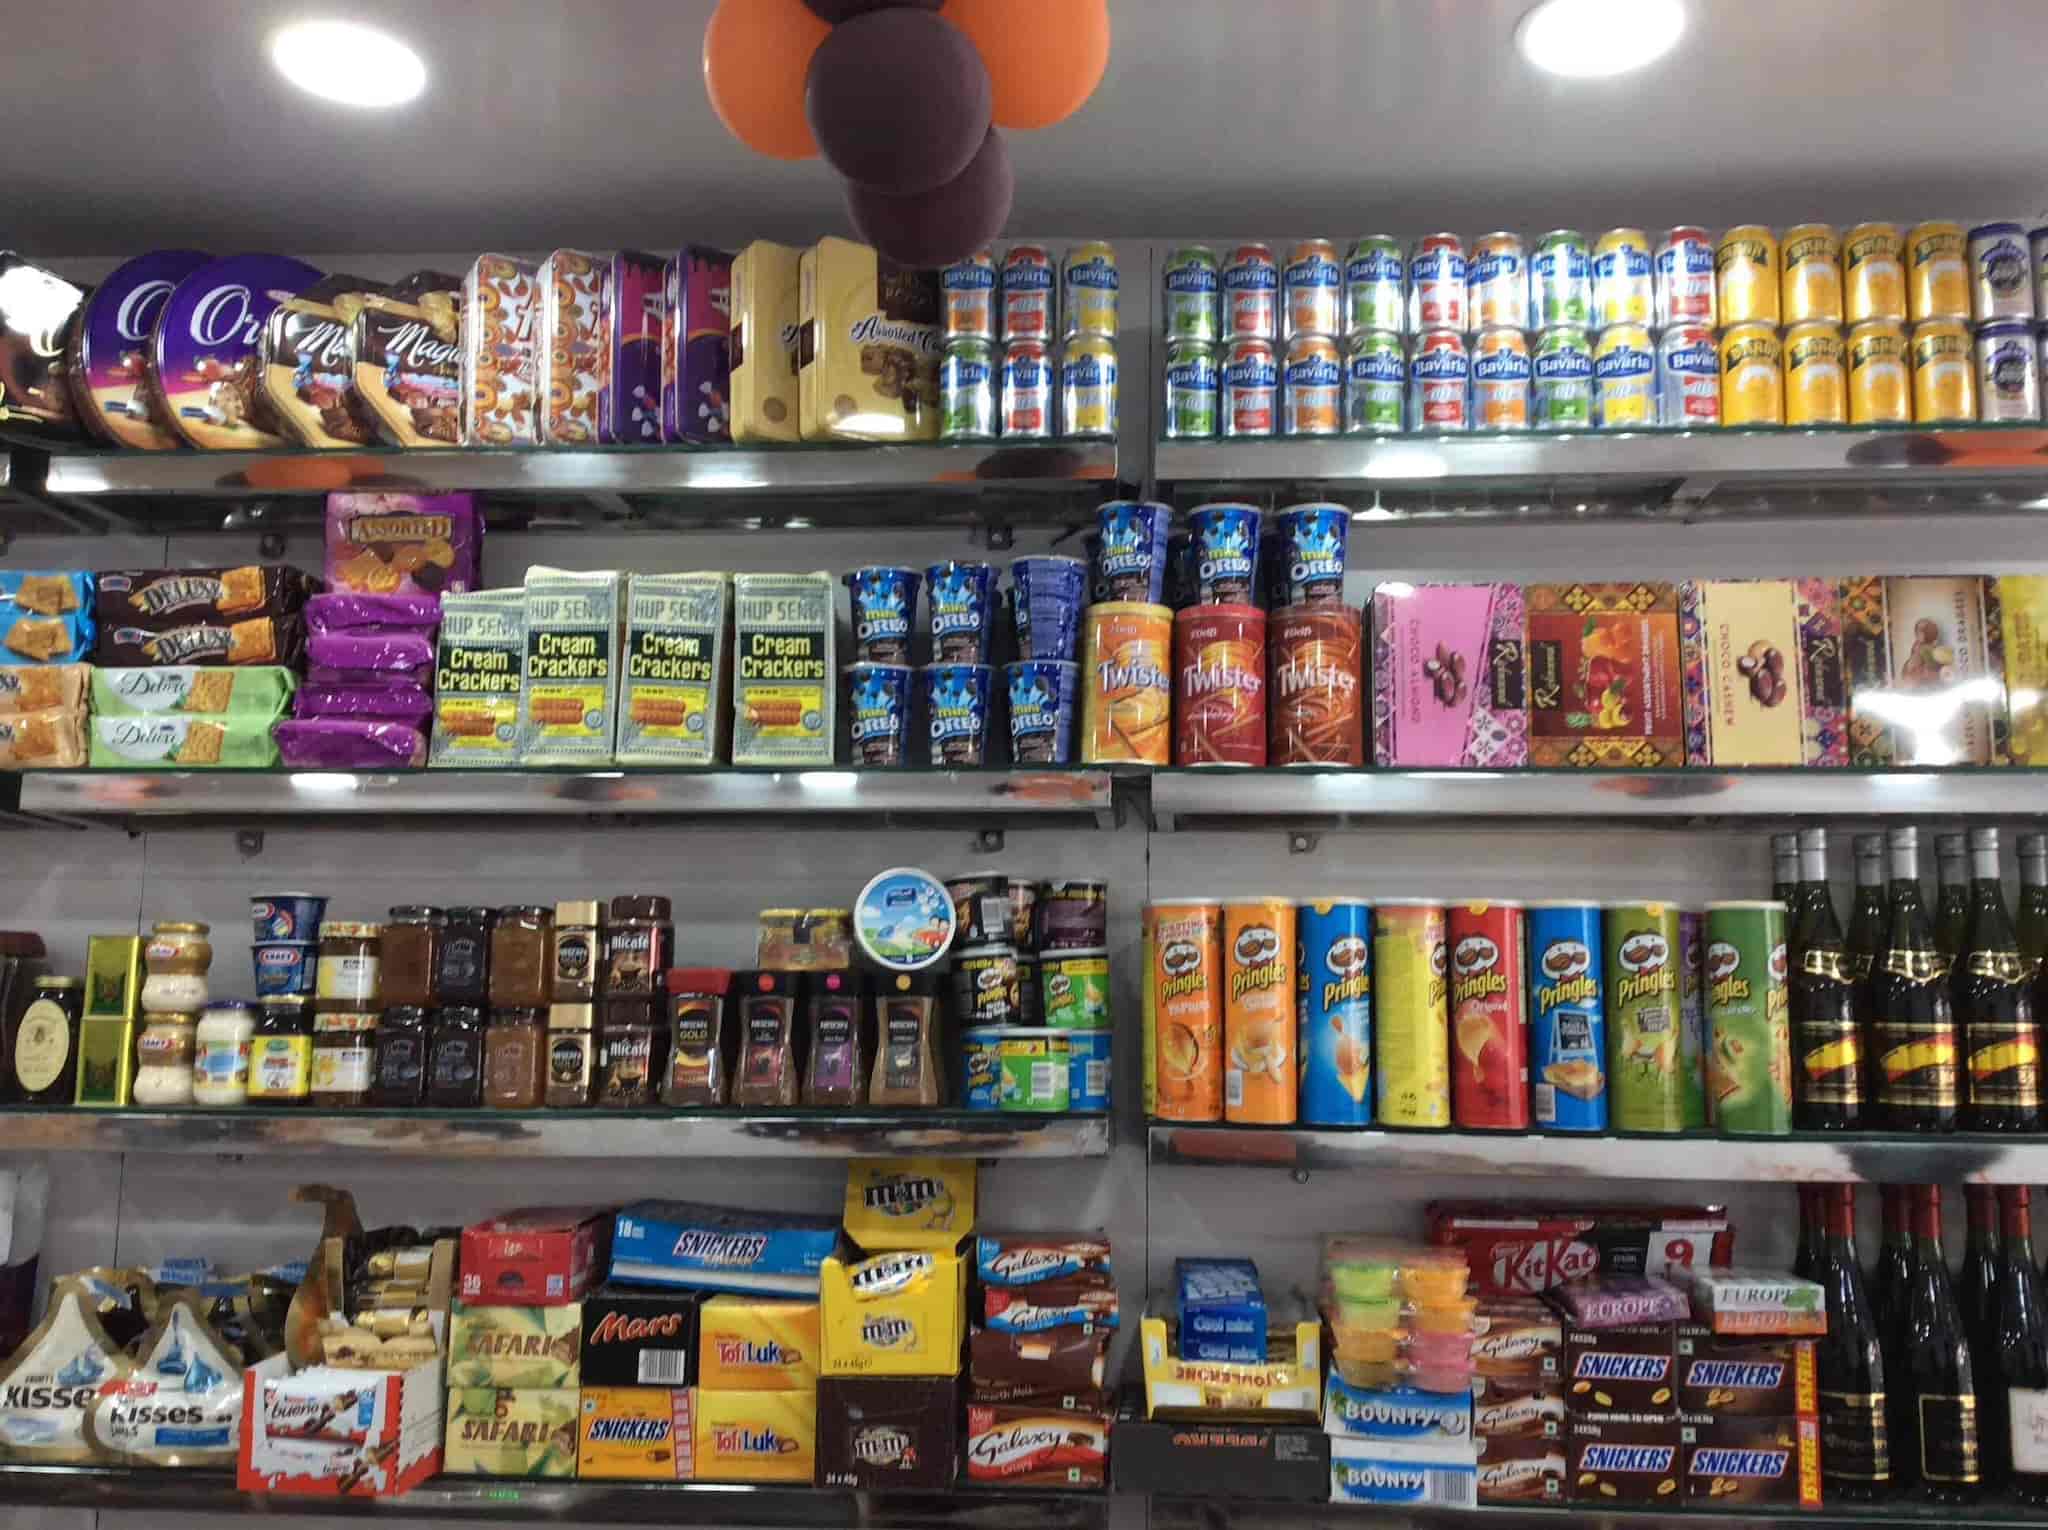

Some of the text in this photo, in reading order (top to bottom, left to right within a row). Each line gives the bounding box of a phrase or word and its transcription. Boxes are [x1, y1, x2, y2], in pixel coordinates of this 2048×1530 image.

[1478, 358, 1528, 376] Bavaria
[1539, 355, 1590, 372] Bavaria
[1598, 355, 1650, 372] Bavaria
[1103, 553, 1148, 575] OREO
[1200, 558, 1250, 578] OREO
[1291, 559, 1343, 580] OREO
[858, 618, 908, 638] OREO
[932, 612, 980, 634] OREO
[539, 633, 596, 656] Cream
[642, 632, 700, 656] Cream
[752, 633, 812, 655] Cream
[1719, 623, 1731, 669] CHOCO
[451, 648, 508, 671] Cream
[528, 654, 608, 678] Crackers
[629, 653, 712, 681] Crackers
[741, 656, 825, 678] Crackers
[438, 669, 521, 692] Crackers
[1183, 662, 1261, 697] Twister
[1278, 662, 1357, 697] Twister
[851, 717, 899, 738] OREO
[931, 717, 981, 738] OREO
[1010, 713, 1056, 736] OREO
[1161, 972, 1208, 1007] Pringles
[1231, 960, 1287, 1001] Pringles
[1618, 968, 1676, 1009] Pringles
[1541, 974, 1598, 1016] Pringles
[676, 1229, 767, 1259] SNICKERS
[1664, 1238, 1695, 1271] 9
[992, 1249, 1068, 1280] Galaxy
[1491, 1236, 1599, 1293] KitKat
[1585, 1299, 1661, 1321] EUROPE
[590, 1311, 683, 1345] Mars
[1482, 1335, 1540, 1358] Galaxy
[1579, 1354, 1667, 1378] SNICKERS
[1690, 1362, 1780, 1387] SNICKERS
[271, 1398, 319, 1419] bueno
[1344, 1399, 1435, 1428] BOUNTY
[1481, 1405, 1540, 1429] Galaxy
[460, 1419, 551, 1442] SAFARI
[590, 1419, 670, 1441] SNICKERS
[969, 1425, 1062, 1465] Galaxy
[1583, 1446, 1674, 1471] SNICKERS
[1694, 1451, 1785, 1475] SNICKERS
[1347, 1467, 1424, 1489] BOUNTY
[1482, 1463, 1541, 1487] Galaxy
